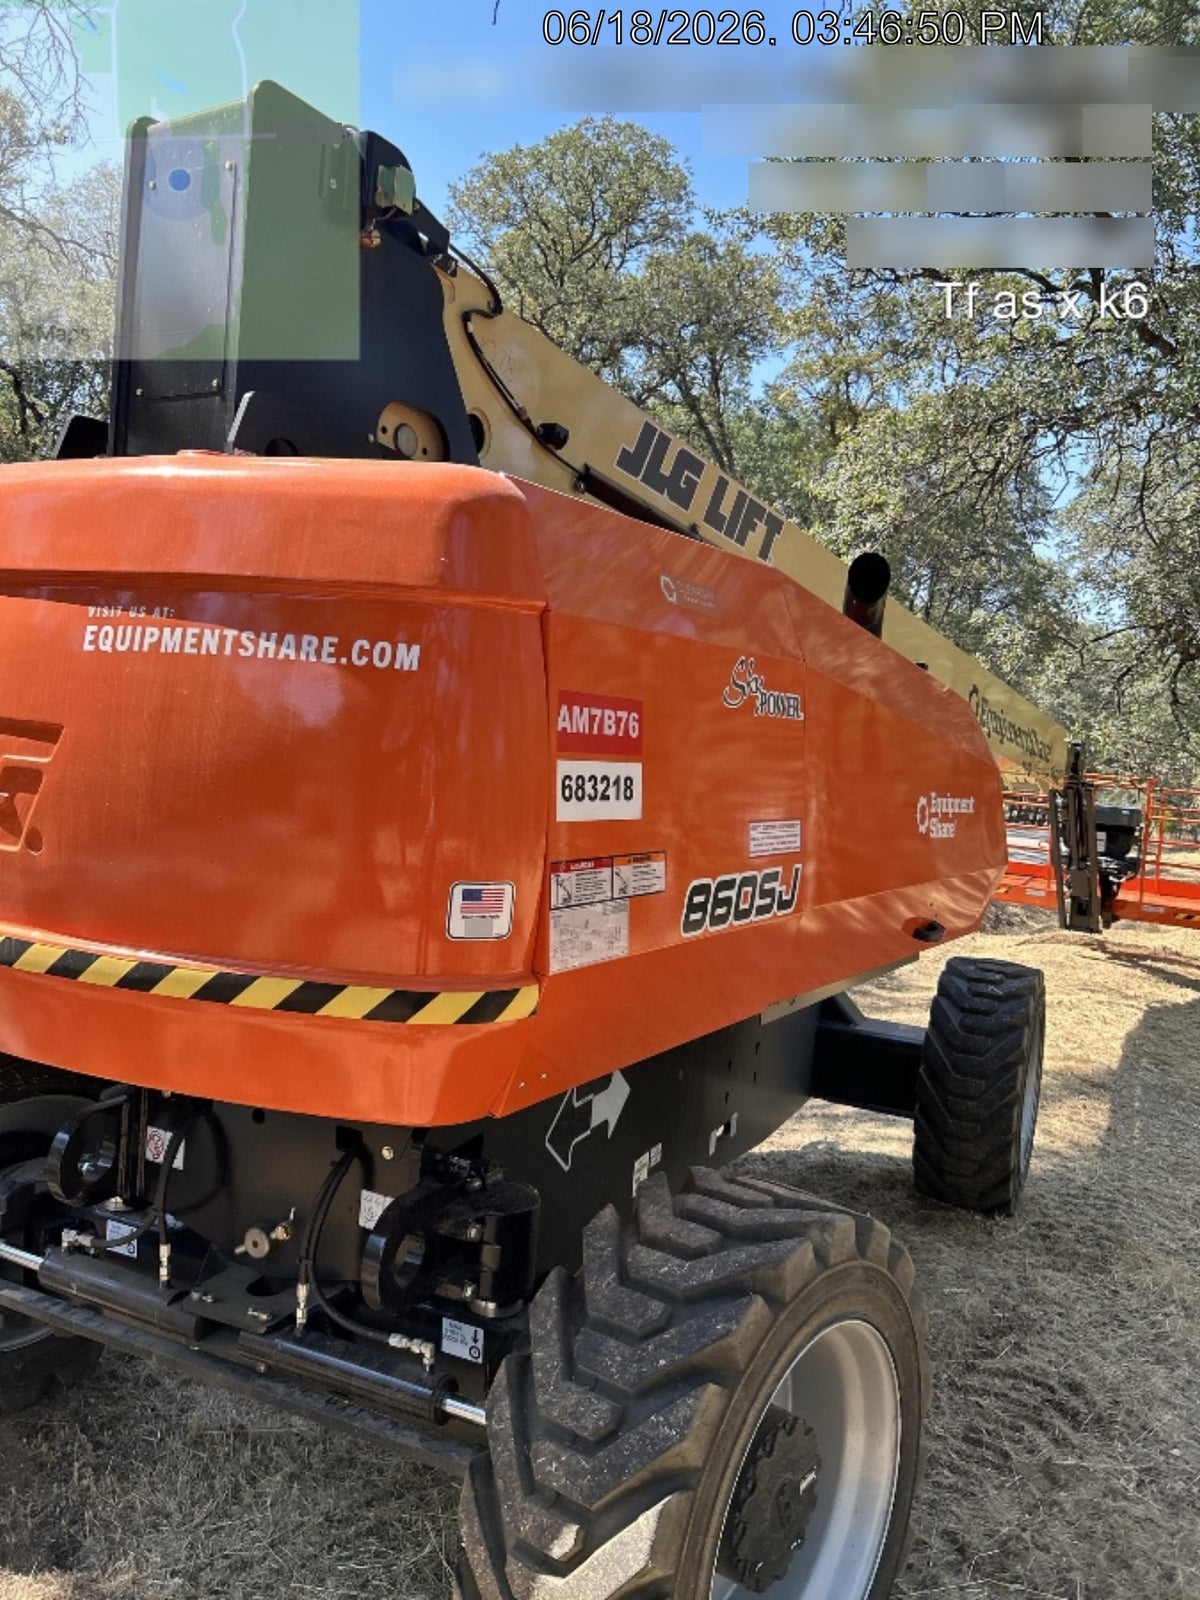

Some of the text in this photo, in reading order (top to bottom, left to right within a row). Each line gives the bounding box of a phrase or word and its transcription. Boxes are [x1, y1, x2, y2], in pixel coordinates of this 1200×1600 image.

[614, 420, 786, 564] JLG LIFT
[88, 606, 121, 617] VISIT
[130, 608, 145, 618] US
[83, 625, 420, 671] EQUIPMENTSHARE.COM
[557, 703, 640, 739] AM7B76
[561, 774, 635, 803] 683218
[930, 791, 974, 818] Equipment
[930, 817, 956, 839] Share
[681, 864, 802, 938] 860SJ
